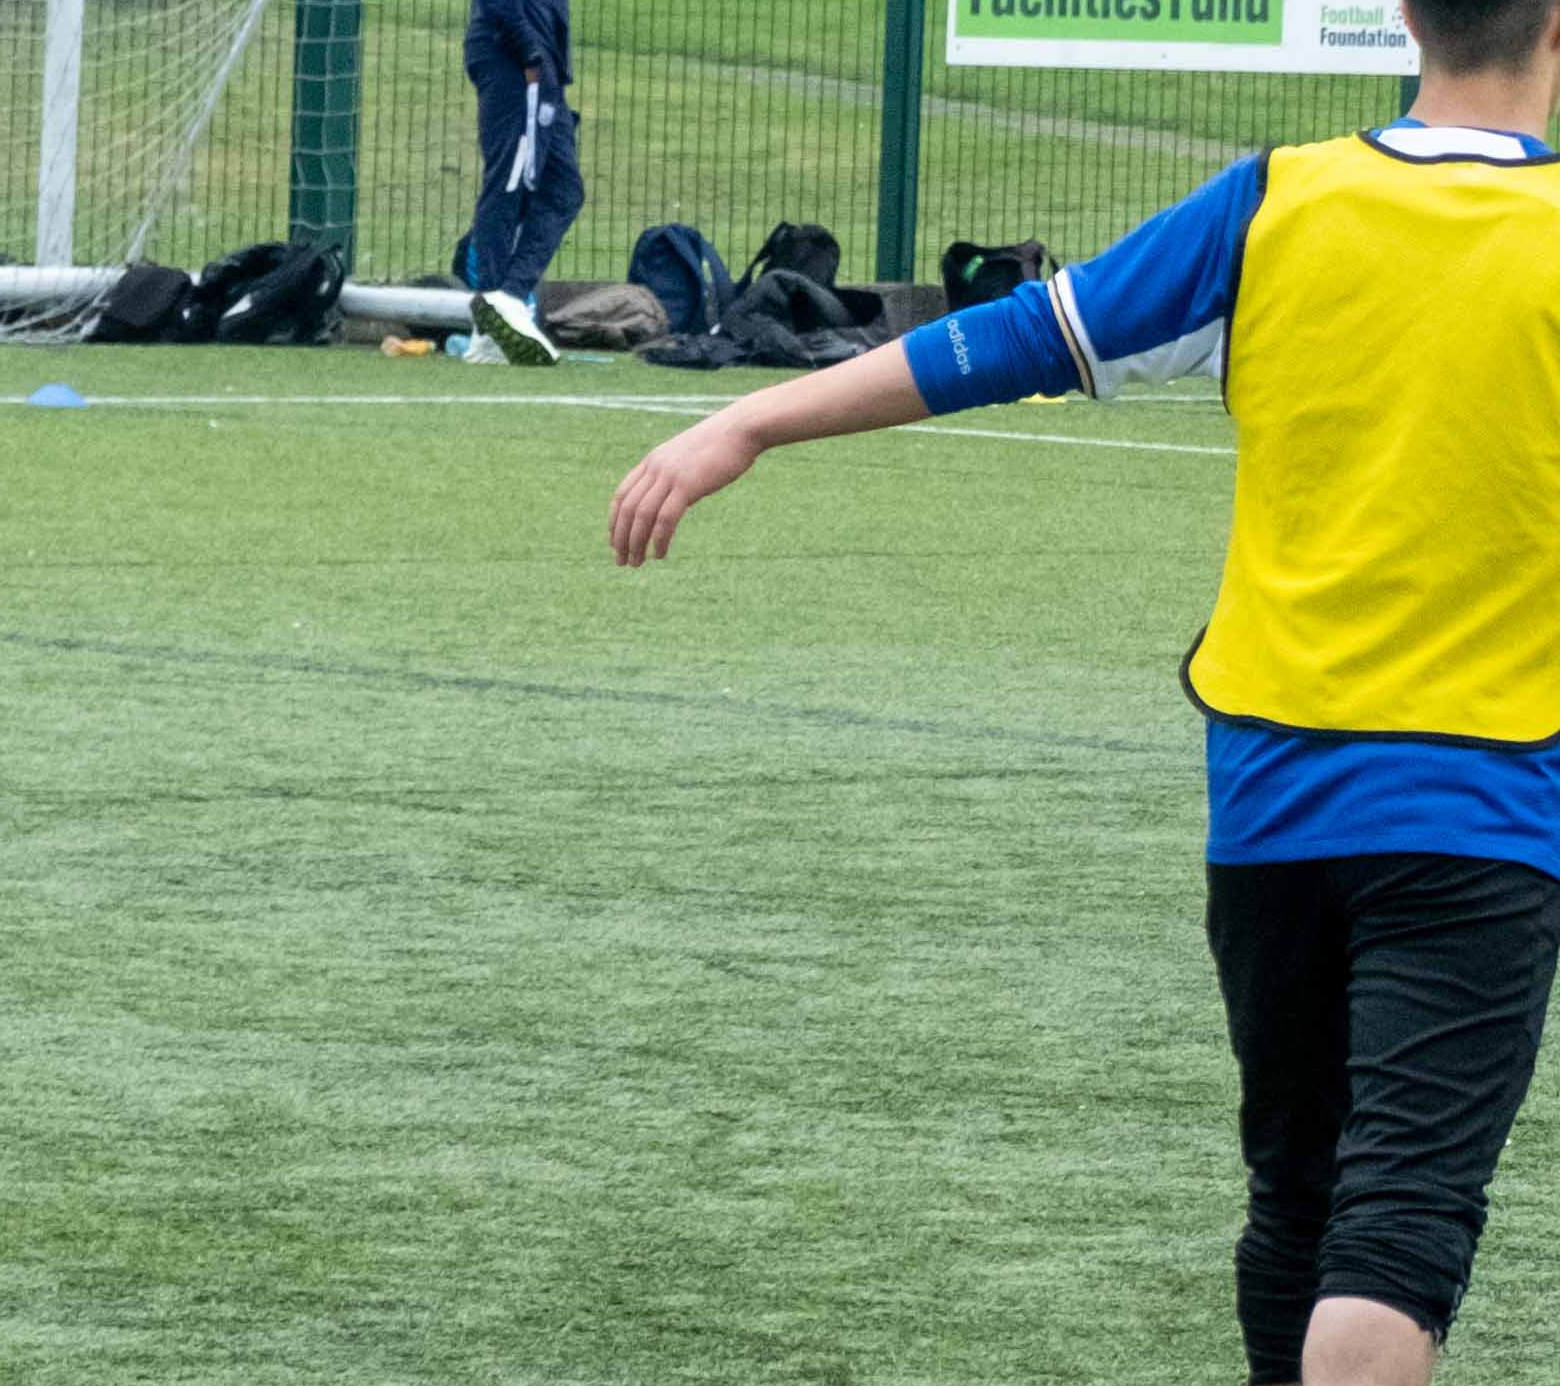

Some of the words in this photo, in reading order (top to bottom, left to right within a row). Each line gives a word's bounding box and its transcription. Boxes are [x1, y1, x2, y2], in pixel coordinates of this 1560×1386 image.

[1320, 5, 1384, 25] Football
[1320, 27, 1407, 47] Foundation
[947, 319, 971, 375] adidas
